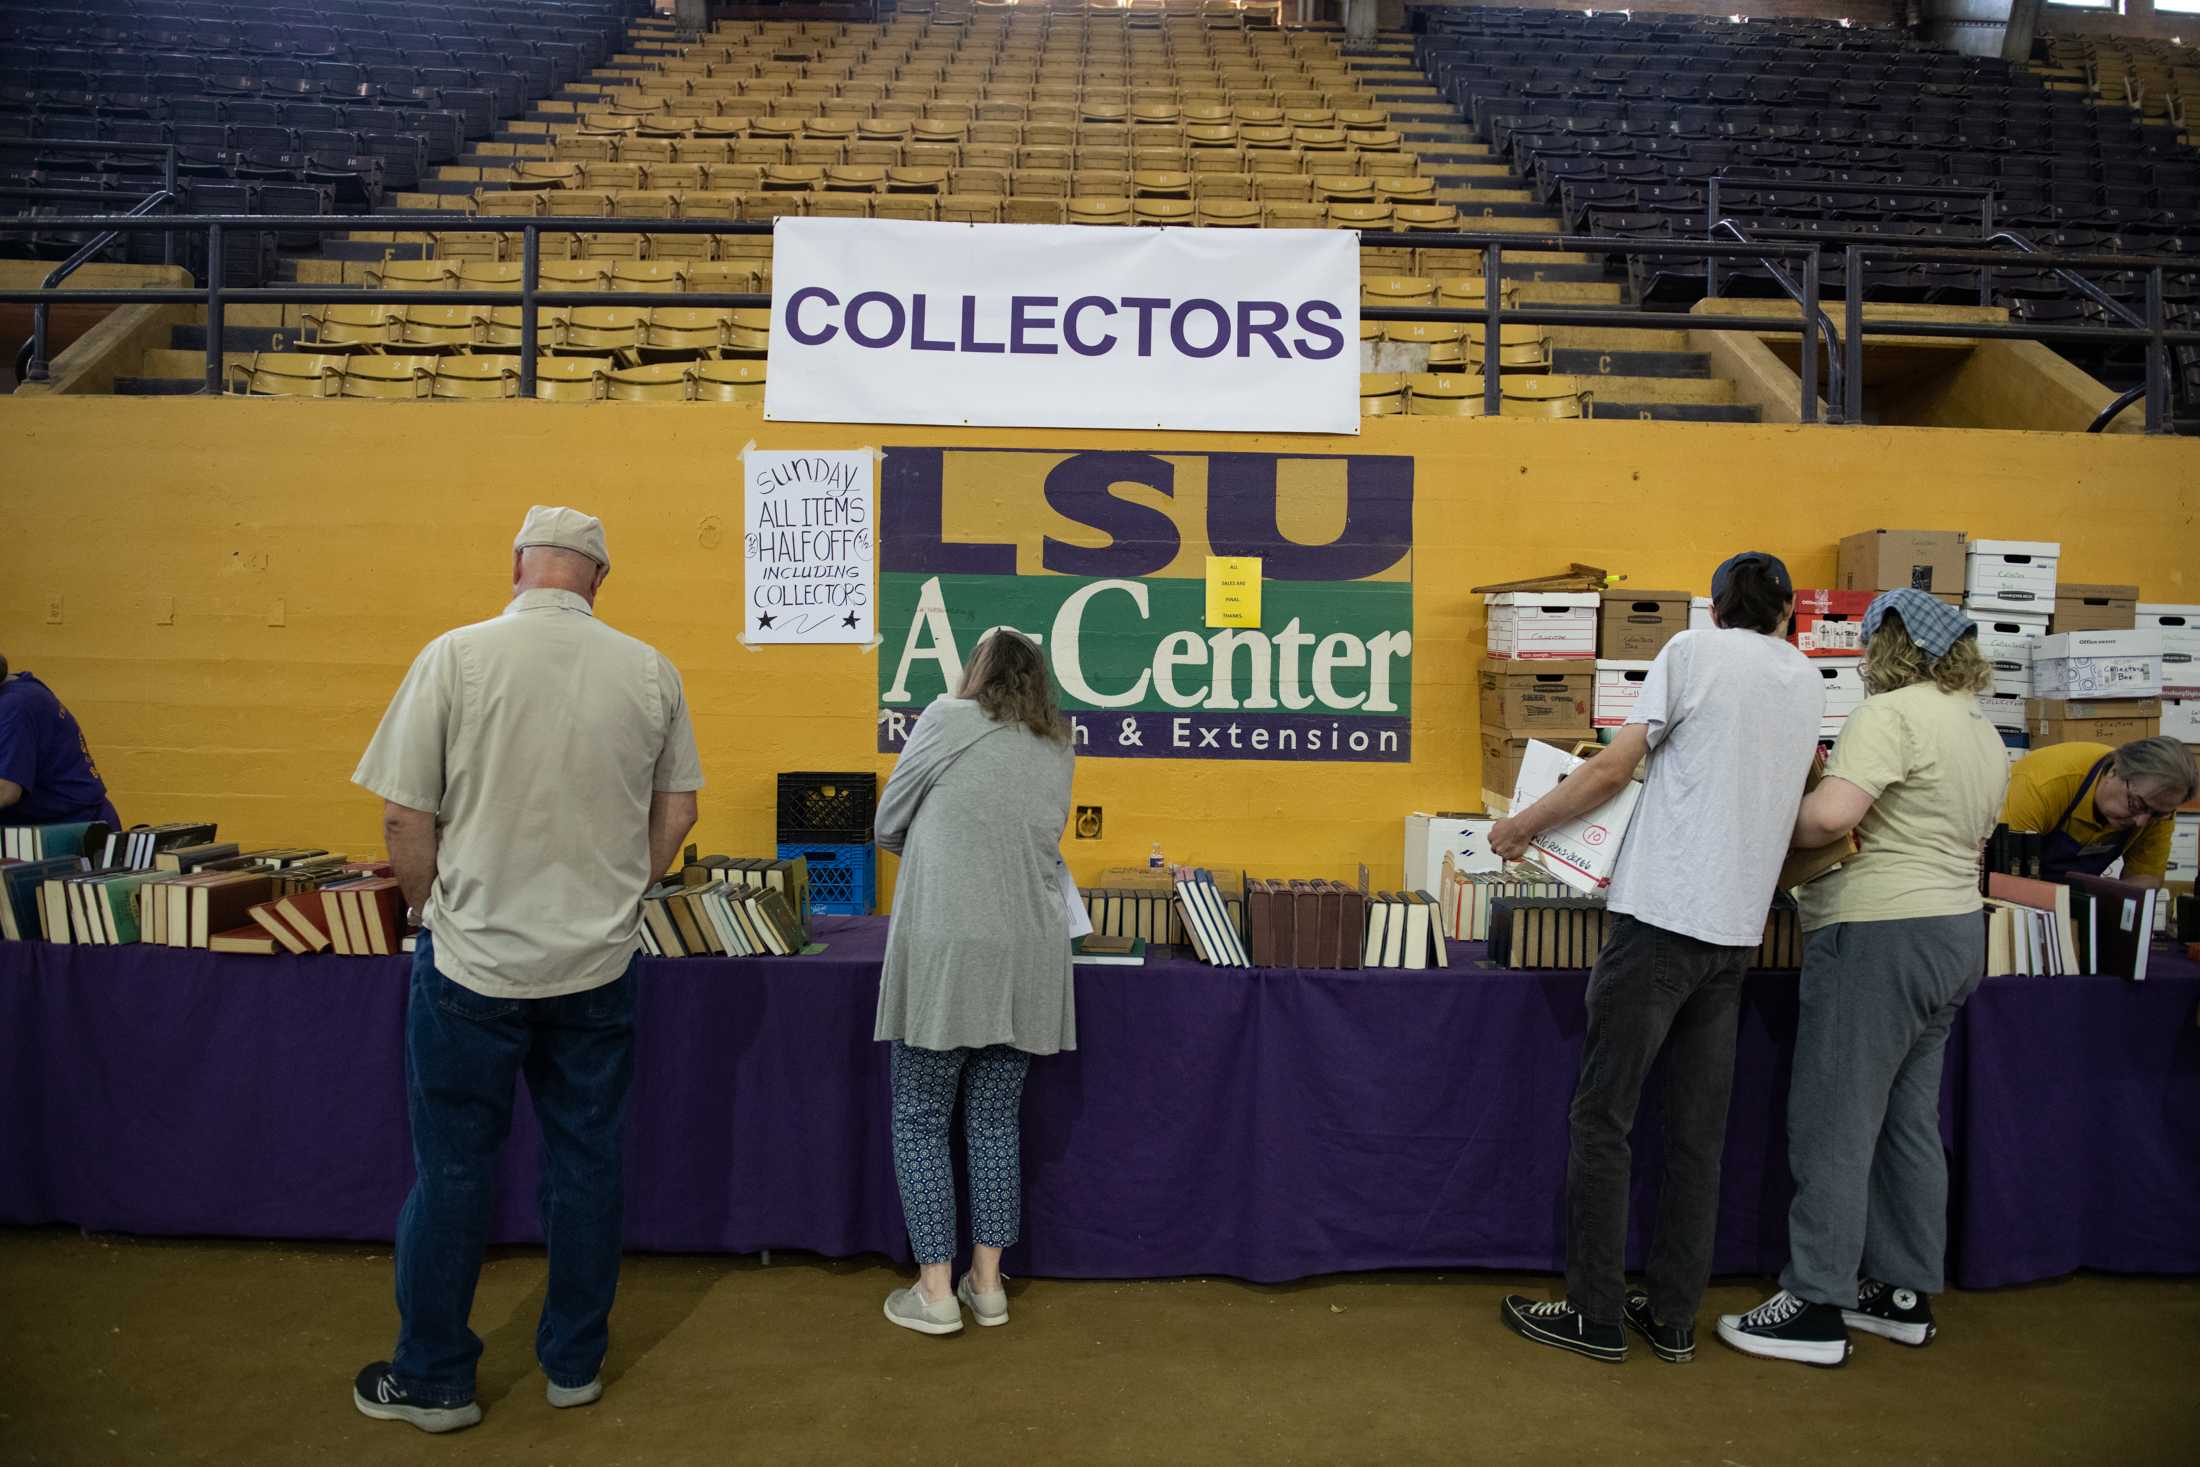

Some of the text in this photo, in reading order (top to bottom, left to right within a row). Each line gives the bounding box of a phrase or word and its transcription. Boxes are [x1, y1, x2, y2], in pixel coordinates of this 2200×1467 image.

[784, 286, 1344, 360] COLLECTORS
[272, 334, 284, 350] C
[1600, 356, 1612, 373] C
[759, 497, 866, 529] ALL ITEMS
[880, 449, 1413, 581] LSU
[759, 531, 811, 563] HALF
[813, 530, 854, 561] OFF
[763, 565, 860, 580] INCLUDING
[754, 583, 867, 609] COLLECTORS
[882, 576, 1412, 712] ACenter
[1118, 717, 1143, 747] &
[1172, 717, 1399, 752] Extension
